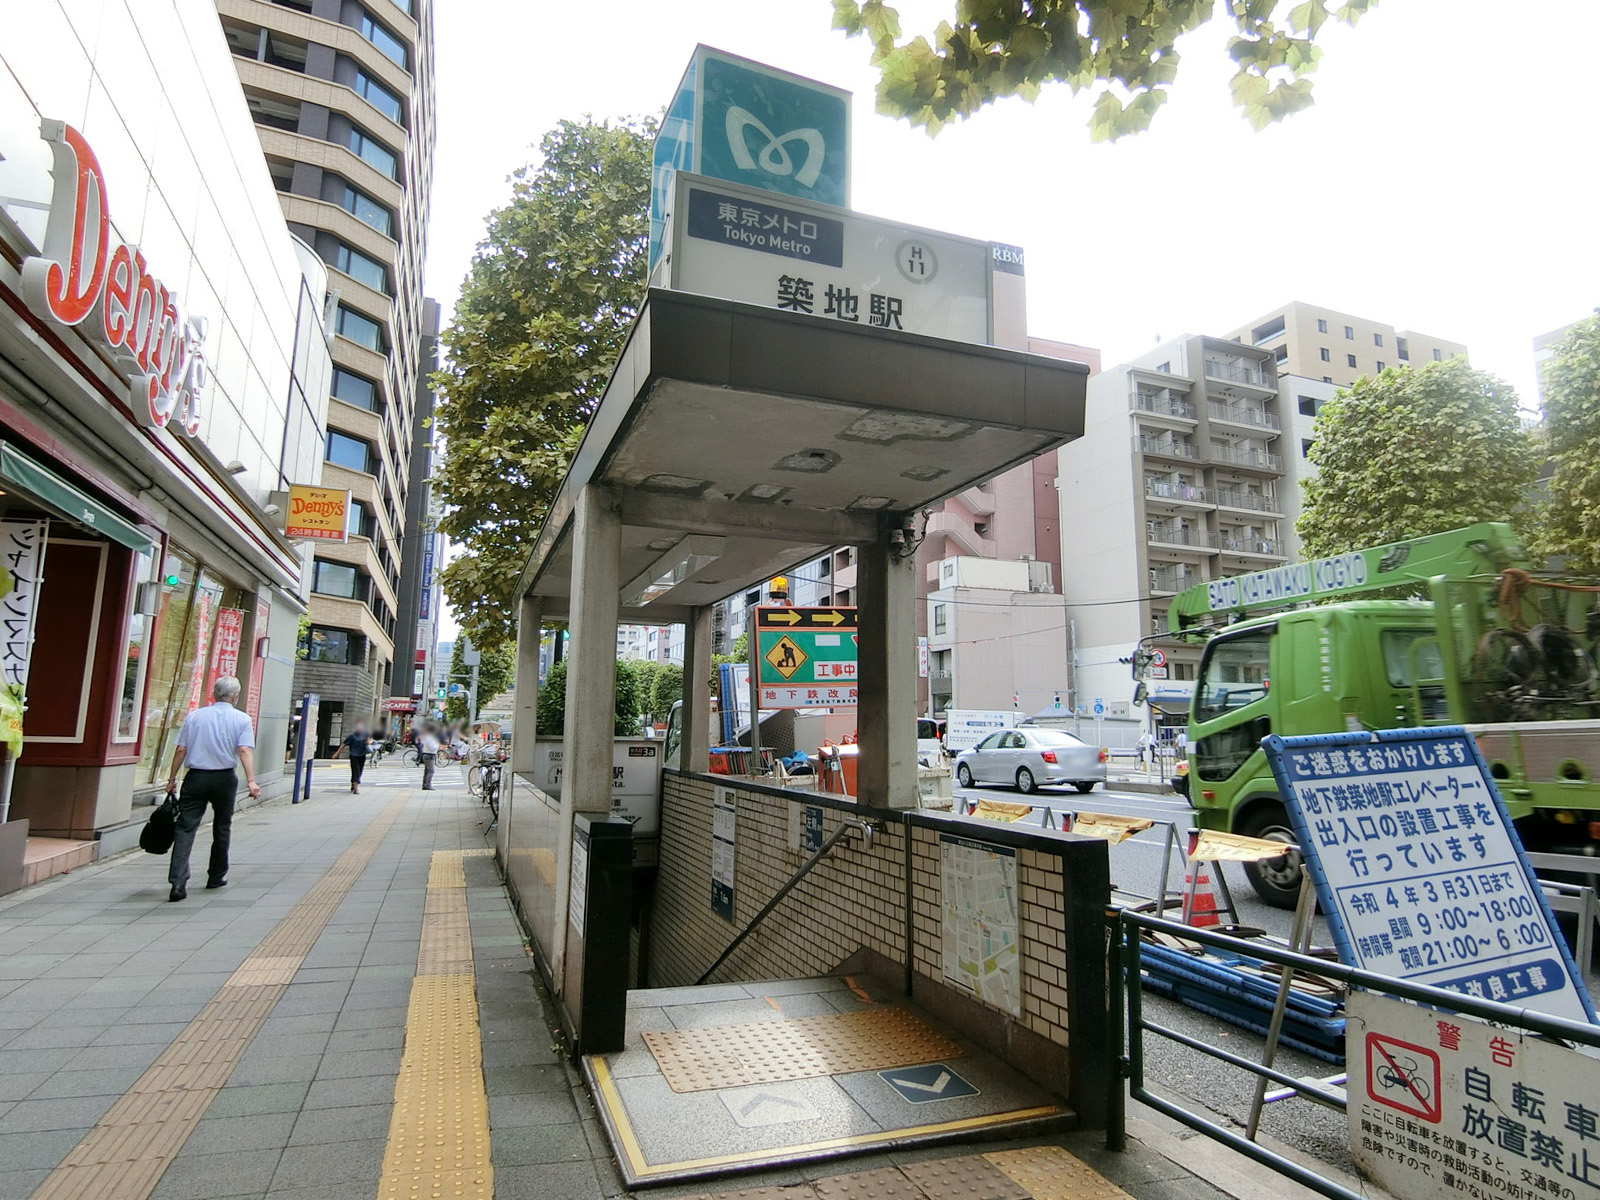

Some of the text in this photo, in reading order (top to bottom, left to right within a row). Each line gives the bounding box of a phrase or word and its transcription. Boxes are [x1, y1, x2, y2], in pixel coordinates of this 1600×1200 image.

[717, 202, 818, 240] 東京メトロ
[723, 224, 811, 256] Tokyo Metro
[911, 246, 922, 260] H
[992, 246, 1024, 266] RBM
[22, 117, 209, 438] Denny's
[908, 260, 925, 276] 11
[777, 273, 904, 331] 築地駅
[291, 497, 345, 518] Denny's
[1207, 552, 1368, 611] SATO KATAWAKU KOGYO
[817, 663, 855, 677] 工事中
[643, 747, 654, 756] 3a
[1291, 741, 1466, 777] ご迷惑をおかけします
[611, 781, 626, 789] ta.
[1300, 775, 1481, 815] 地下鉄築地駅エレベーター・
[1316, 801, 1495, 848] 出入口の設置工事を
[1346, 832, 1488, 878] 行っています
[1358, 932, 1394, 960] 時間帯
[1388, 916, 1413, 940] 昼間
[1398, 945, 1424, 971] 夜間
[1436, 1020, 1515, 1068] 警告
[1464, 1066, 1600, 1141] 自転車
[1462, 1104, 1600, 1189] 放置禁止
[1362, 1136, 1504, 1200] 危険ですので、置かない
